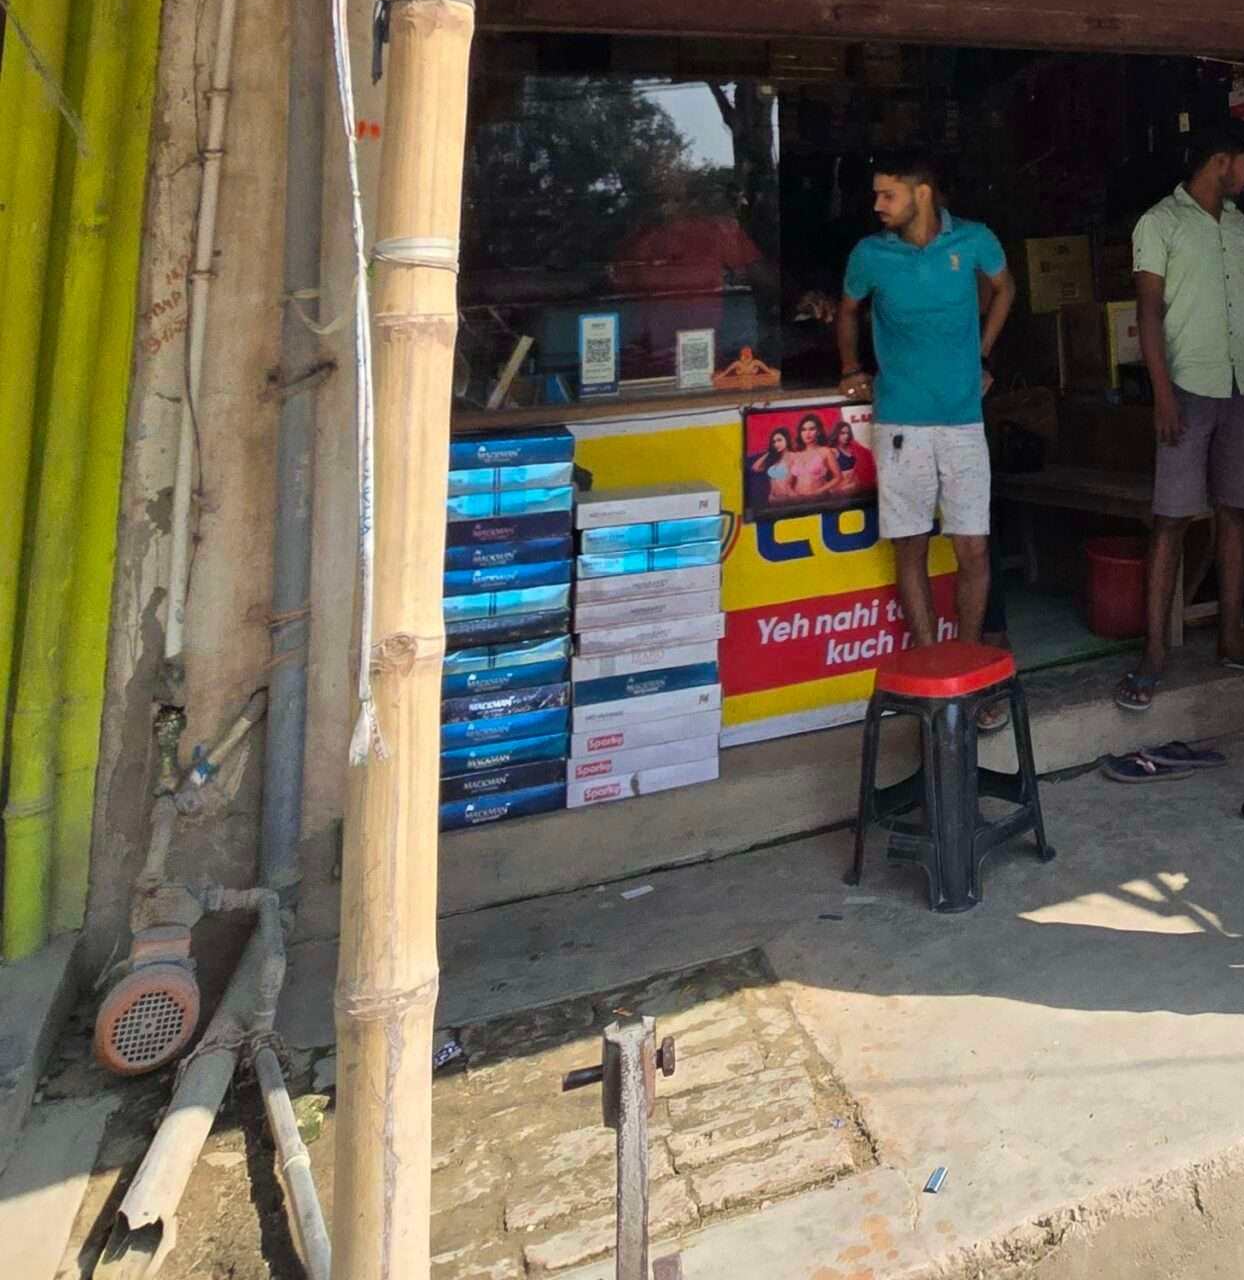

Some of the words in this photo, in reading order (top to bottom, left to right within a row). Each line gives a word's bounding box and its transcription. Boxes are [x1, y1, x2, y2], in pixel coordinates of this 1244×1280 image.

[758, 613, 810, 644] Yeh
[815, 599, 879, 635] nahi
[826, 630, 894, 664] kuch
